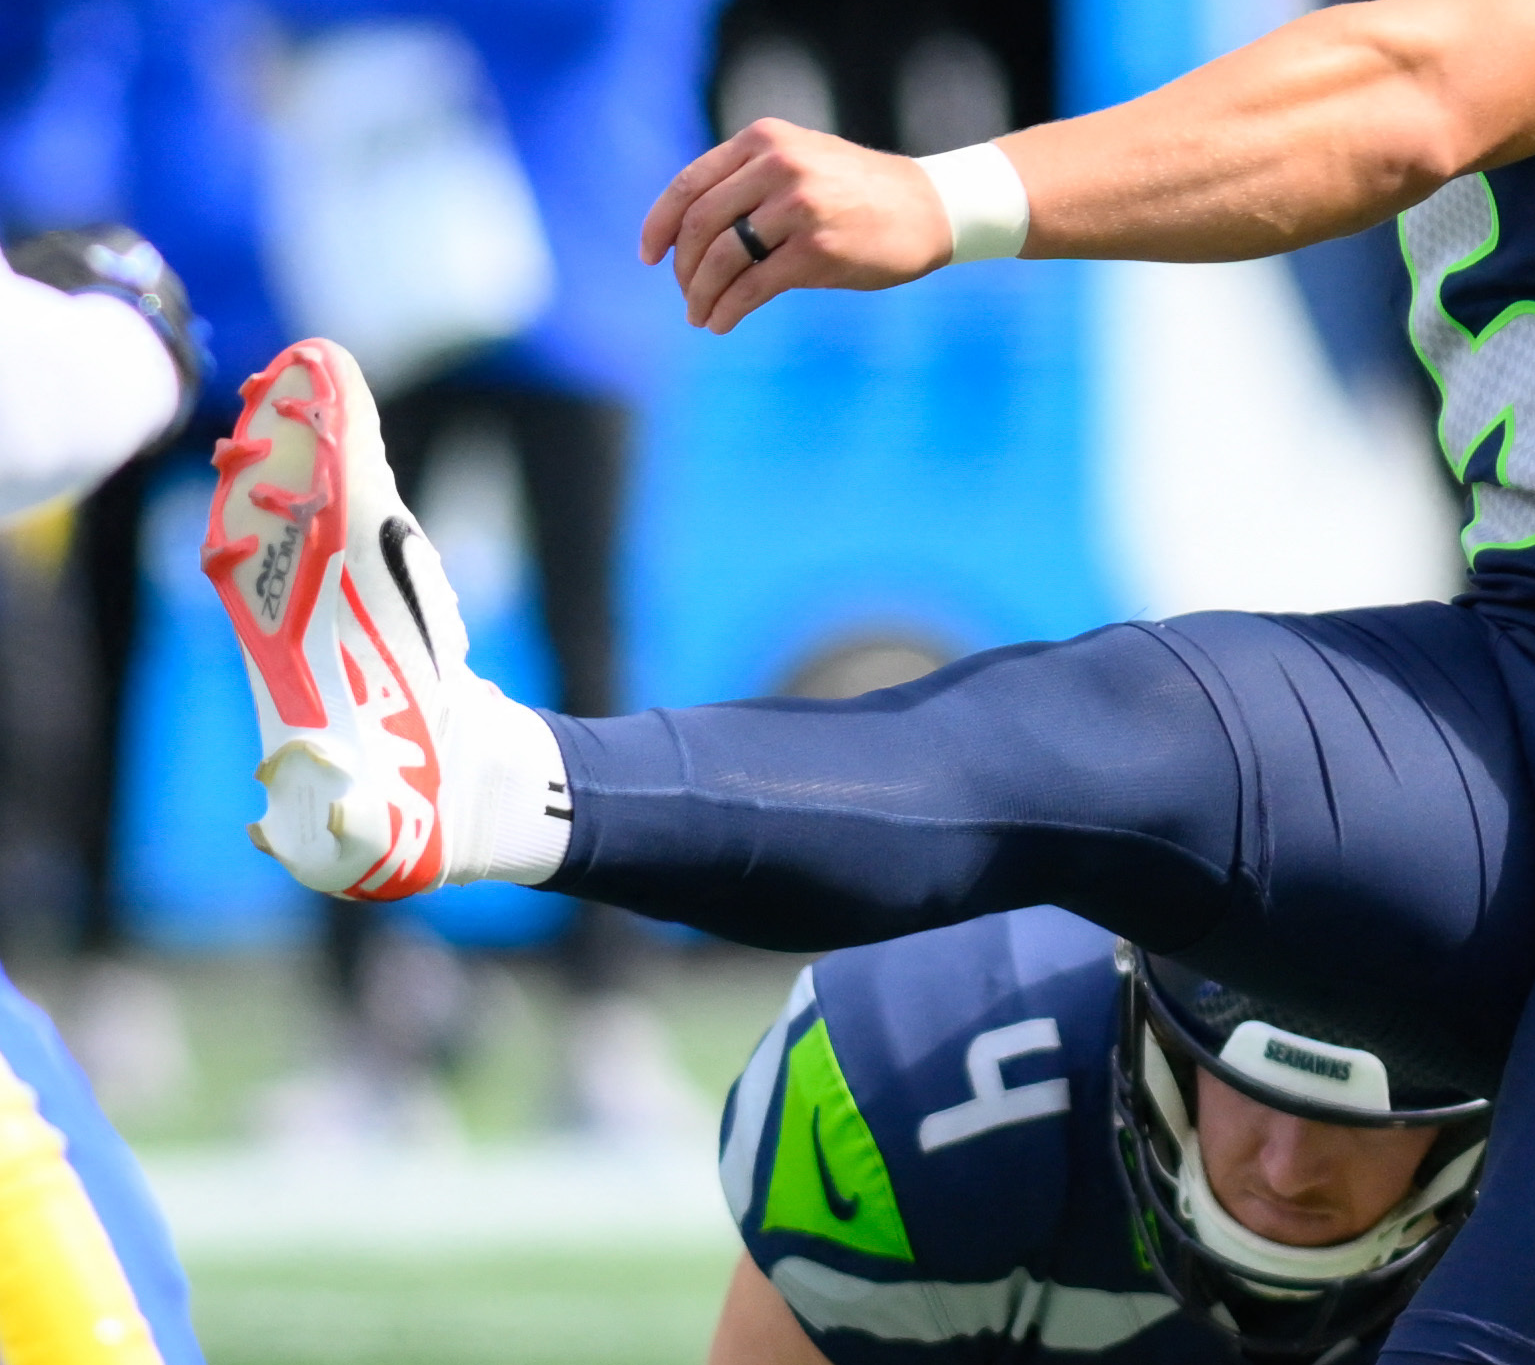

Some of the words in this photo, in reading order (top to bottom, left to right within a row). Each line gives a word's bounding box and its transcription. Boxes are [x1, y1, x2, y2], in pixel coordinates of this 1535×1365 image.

[261, 524, 300, 622] ZOOM
[918, 1016, 1071, 1154] 4
[1264, 1038, 1352, 1081] SEAHAWKS
